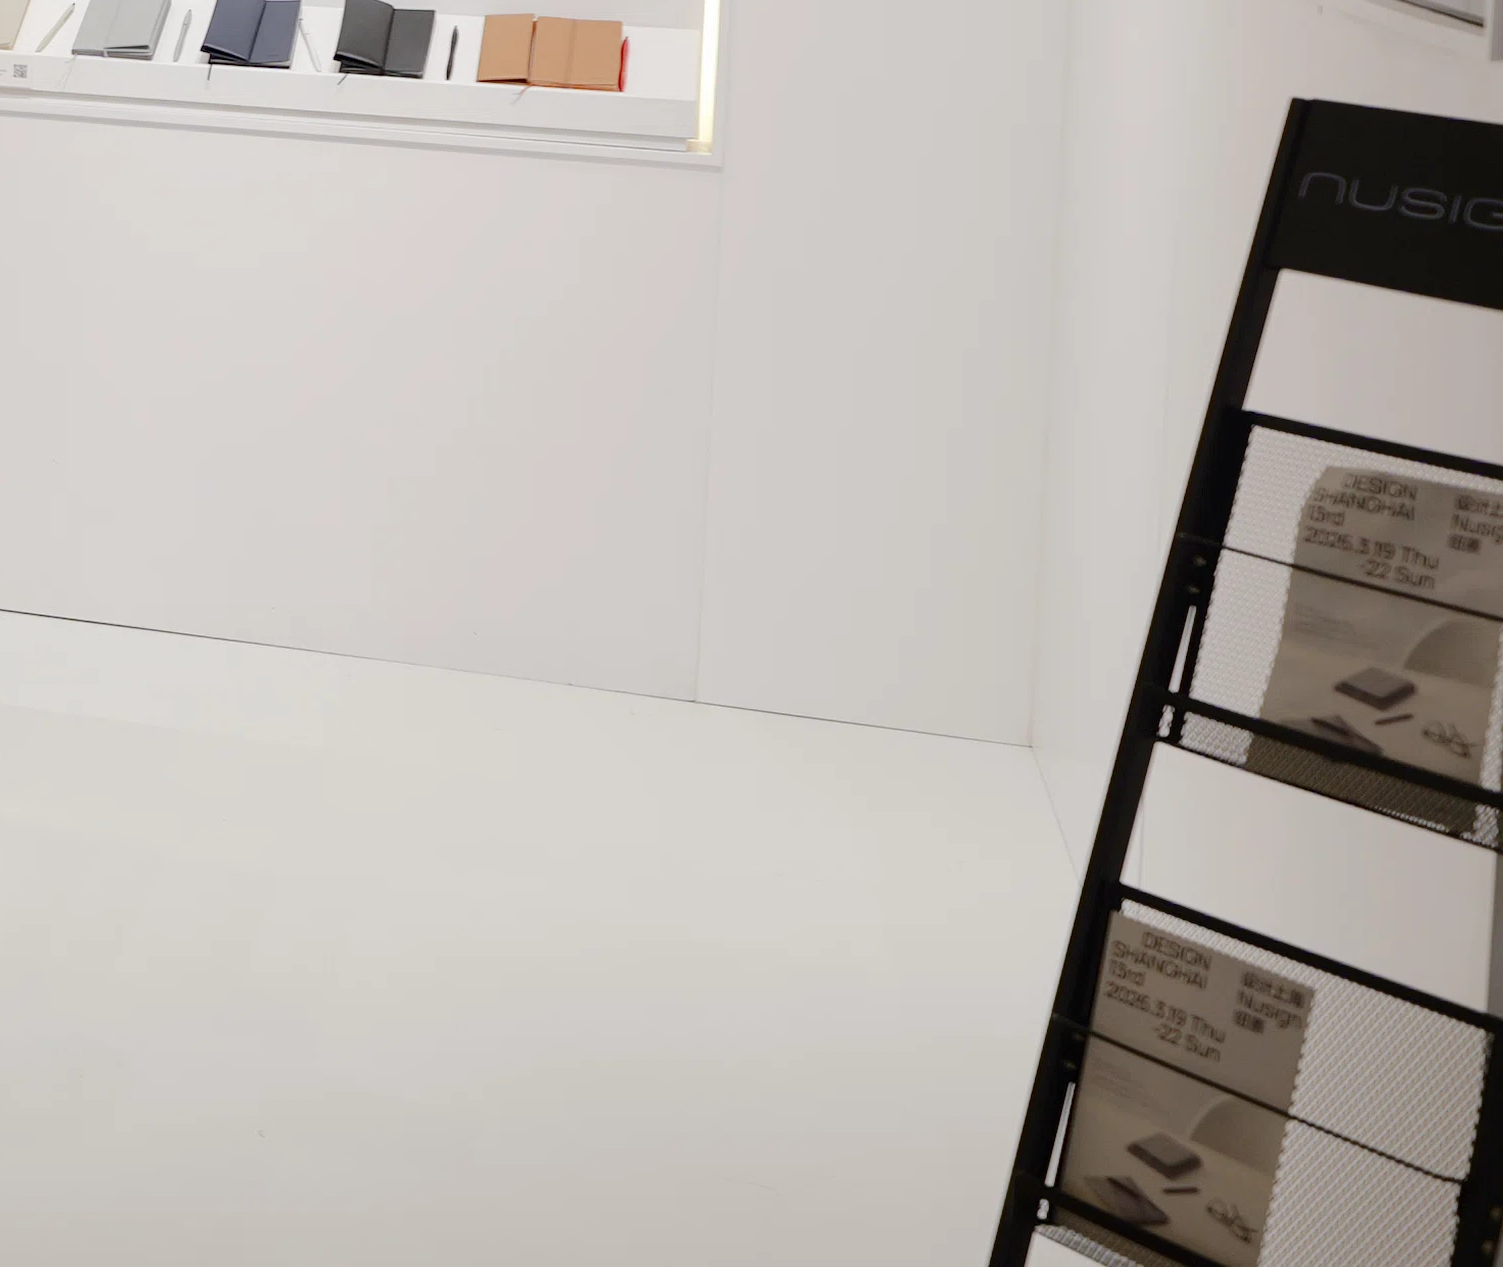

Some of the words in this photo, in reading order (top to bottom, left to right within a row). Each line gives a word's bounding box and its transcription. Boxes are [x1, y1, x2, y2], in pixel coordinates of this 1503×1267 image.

[1343, 474, 1418, 500] DESIGN
[1308, 504, 1345, 527] 13rd
[1314, 487, 1415, 521] SHANGHAI
[1450, 513, 1503, 545] Nusig
[1112, 940, 1208, 991] SHANGHAI
[1143, 931, 1212, 972] DESIGN
[1109, 959, 1145, 987] 13rd
